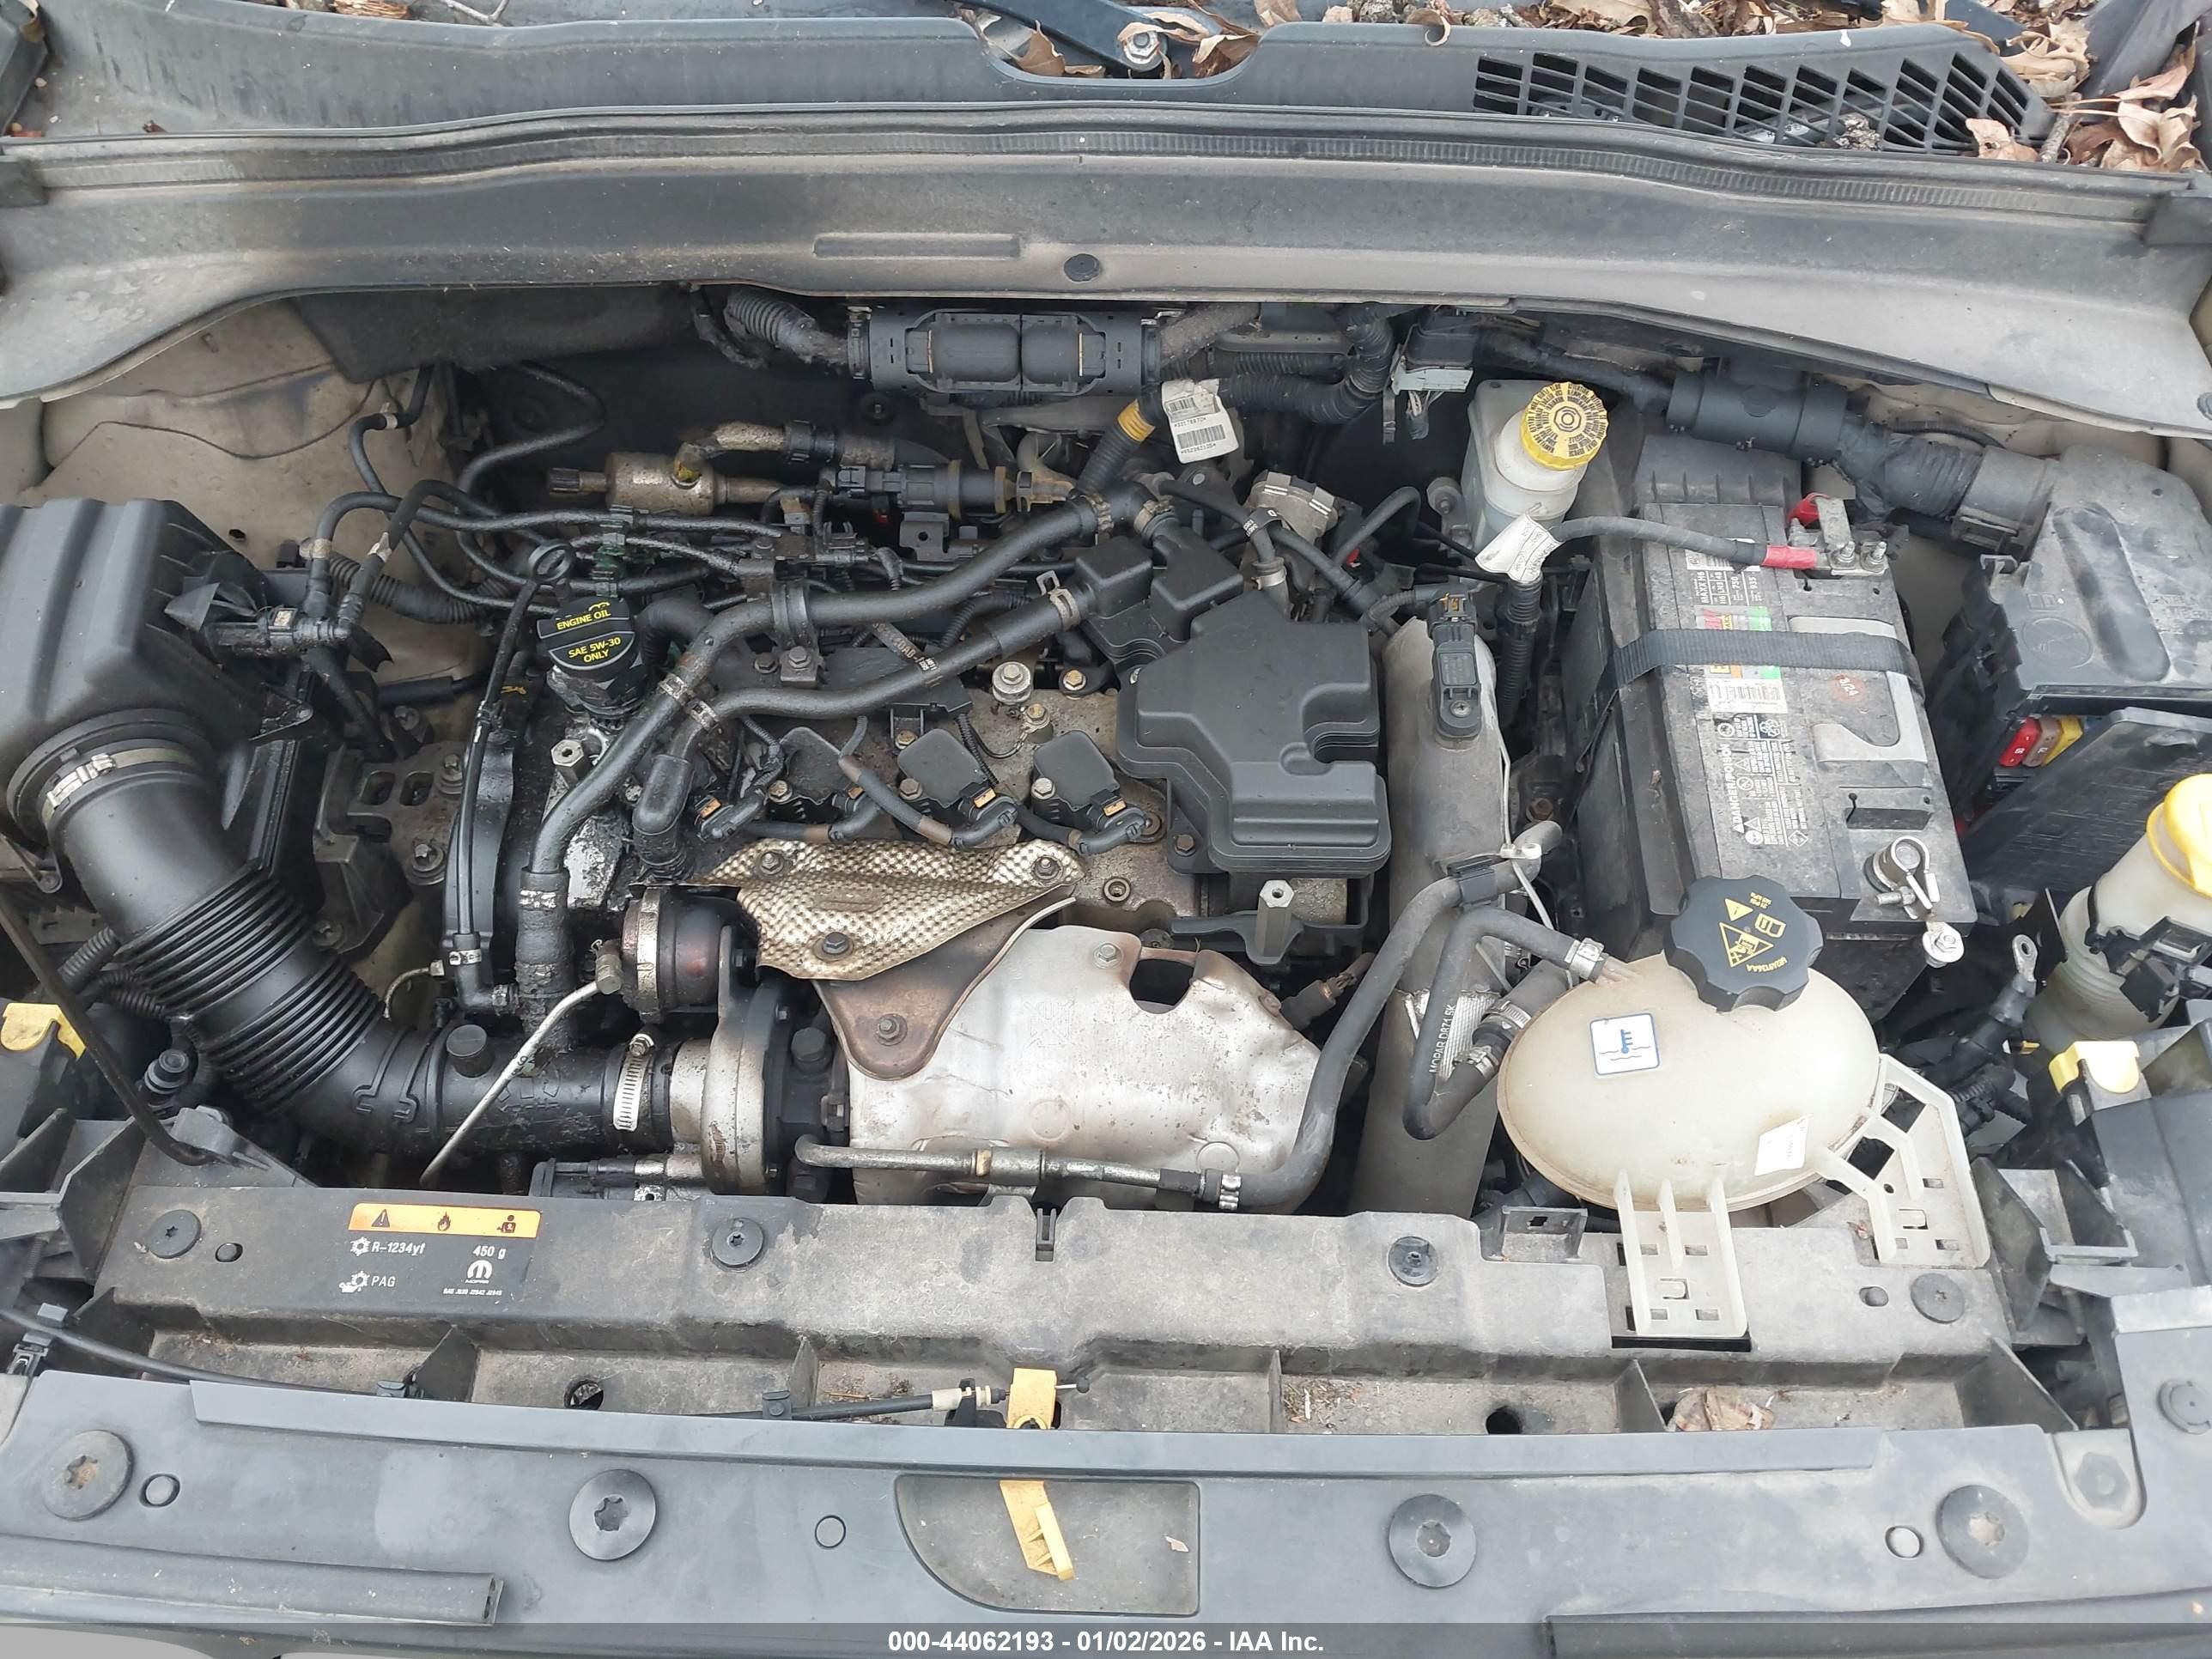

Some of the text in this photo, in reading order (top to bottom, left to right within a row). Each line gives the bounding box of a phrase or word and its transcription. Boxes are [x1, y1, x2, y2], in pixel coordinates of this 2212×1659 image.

[556, 610, 611, 630] ENGINE OIL
[568, 637, 621, 658] SAE 5W-30
[583, 649, 610, 663] ONLY
[371, 1242, 507, 1260] R-1234yf 450 g
[371, 1275, 397, 1287] PAG
